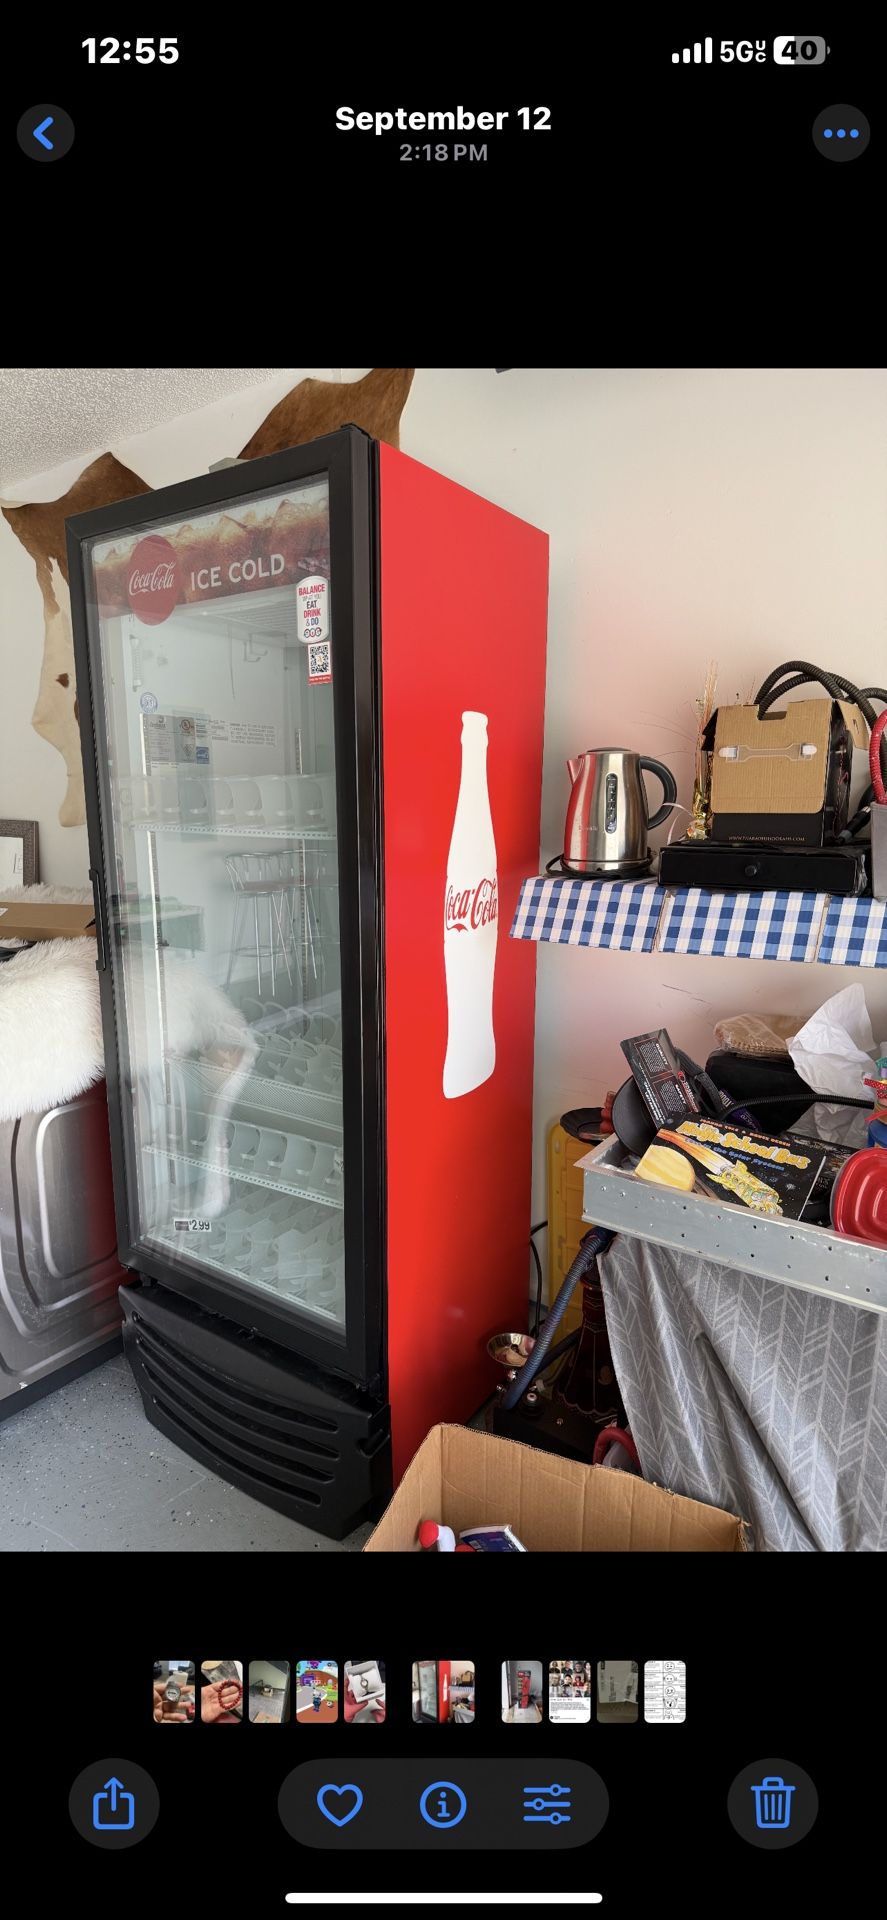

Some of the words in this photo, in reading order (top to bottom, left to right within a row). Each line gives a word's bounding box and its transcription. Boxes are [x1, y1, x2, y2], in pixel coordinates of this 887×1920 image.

[128, 562, 176, 596] Coca-Cola
[190, 567, 222, 591] ICE
[229, 554, 285, 583] COLD
[299, 584, 326, 596] BALANCE
[303, 608, 321, 618] DRINK
[306, 600, 318, 609] EAT
[310, 617, 319, 625] DO
[446, 878, 498, 932] Coca-Cola
[713, 1146, 727, 1154] the
[753, 1158, 785, 1172] System
[720, 1132, 775, 1160] School
[772, 1148, 811, 1169] Bus
